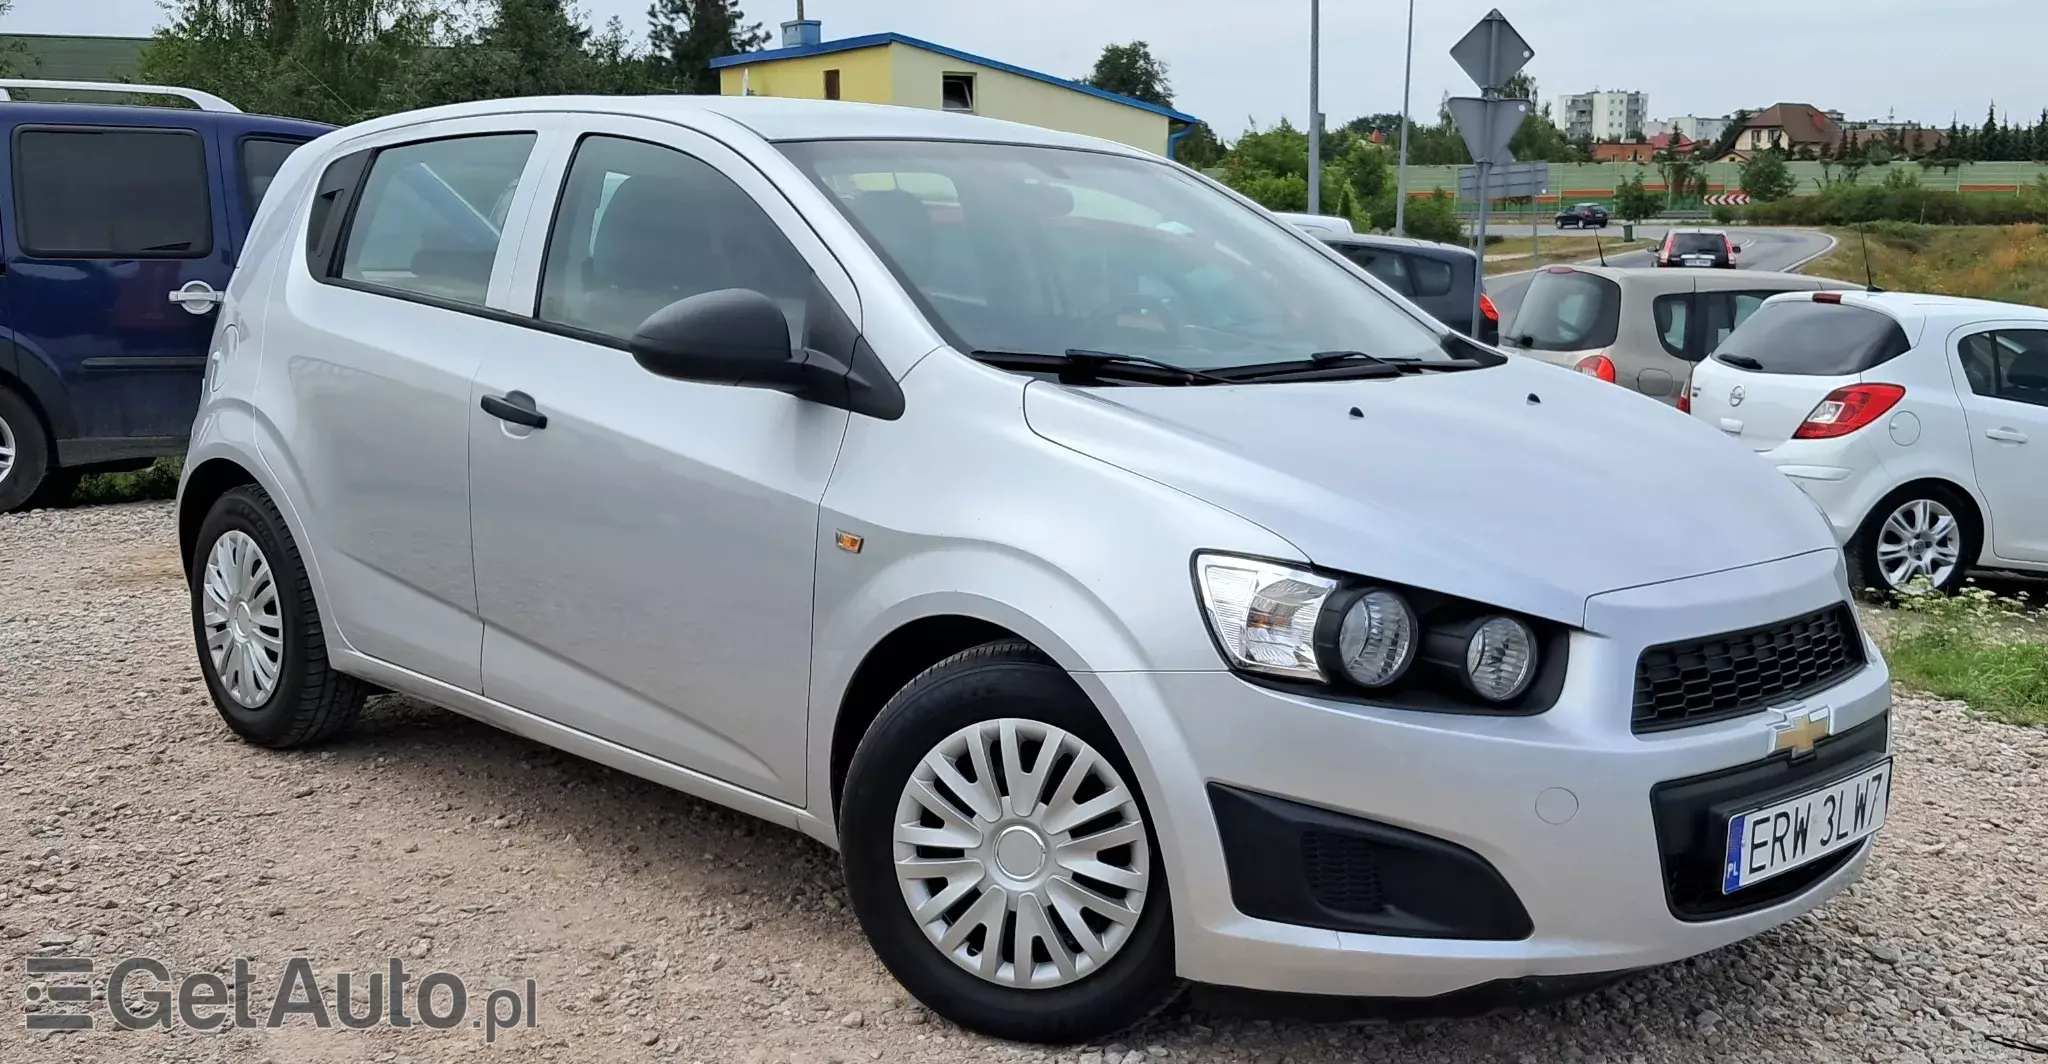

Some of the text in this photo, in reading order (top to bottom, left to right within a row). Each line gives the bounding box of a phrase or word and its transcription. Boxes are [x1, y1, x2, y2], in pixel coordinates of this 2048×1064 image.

[1748, 772, 1884, 875] ERW 3LW7
[1726, 863, 1739, 877] PL
